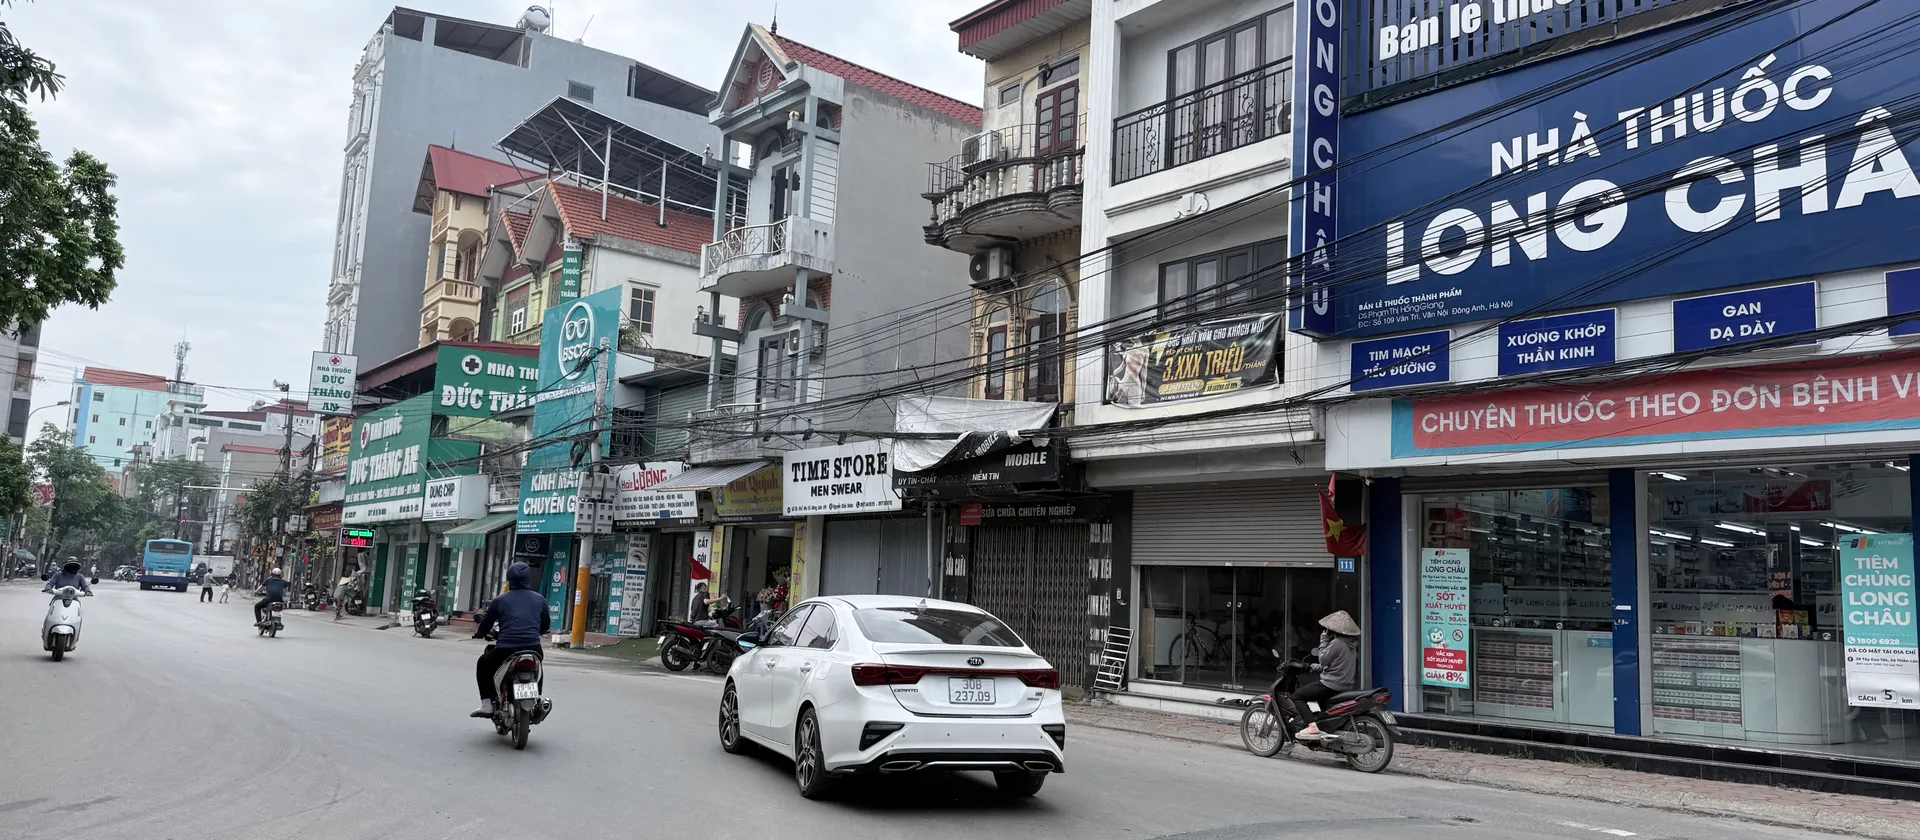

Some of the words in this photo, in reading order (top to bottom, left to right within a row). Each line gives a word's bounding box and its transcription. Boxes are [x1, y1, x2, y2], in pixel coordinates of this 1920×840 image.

[1380, 17, 1438, 60] Bán
[1491, 110, 1601, 177] NHÀ
[1618, 53, 1832, 151] THUỐC
[1311, 137, 1333, 316] CHÂU
[1386, 179, 1628, 286] LONG
[1358, 302, 1374, 311] BÁN
[1375, 300, 1383, 309] LẺ
[1384, 295, 1410, 308] THUỐC
[1411, 292, 1438, 303] THÀNH
[1439, 287, 1462, 300] PHẨM
[1373, 316, 1382, 326] Số
[1384, 316, 1395, 325] 109
[1437, 309, 1449, 318] Nội
[1452, 306, 1470, 316] Đông
[1471, 304, 1488, 313] Anh,
[1489, 302, 1500, 310] Hà
[1501, 300, 1514, 309] Nội
[1722, 301, 1761, 318] GAN
[1213, 328, 1226, 341] CHO
[1227, 323, 1250, 338] KHÁCH
[1507, 330, 1561, 348] XƯƠNG
[1564, 323, 1606, 341] KHỚP
[1710, 326, 1734, 342] DẠ
[1740, 320, 1776, 337] DÀY
[1369, 350, 1389, 362] TIM
[1392, 344, 1431, 361] MẠCH
[1517, 349, 1556, 365] THẦN
[1559, 345, 1595, 360] KINH
[487, 361, 515, 378] NHÀ
[1162, 353, 1203, 382] 3.XXX
[1389, 360, 1437, 376] ĐƯỜNG
[321, 374, 345, 385] ĐỨC
[312, 386, 351, 399] THẮNG
[441, 382, 484, 410] ĐỨC
[322, 402, 339, 413] AN
[1421, 404, 1516, 434] CHUYÊN
[1524, 391, 1615, 427] THUỐC
[1627, 387, 1702, 418] THEO
[1711, 384, 1781, 413] ĐƠN
[1793, 373, 1878, 413] BỆNH
[975, 430, 1000, 457] MOBILE
[791, 459, 830, 482] TIME
[833, 452, 888, 479] STORE
[1005, 451, 1048, 467] MOBILE
[531, 470, 557, 492] KÍNH
[621, 479, 633, 490] Hair
[898, 478, 907, 486] UY
[988, 472, 1000, 480] TIN
[810, 485, 829, 497] MEN
[831, 482, 863, 496] SWEAR
[523, 491, 565, 515] CHUYÊN
[981, 504, 995, 518] SỬA
[996, 504, 1016, 518] CHỮA
[1018, 505, 1046, 517] CHUYÊN
[1048, 503, 1077, 516] NGHIỆP
[1340, 560, 1353, 569] 111
[1446, 565, 1466, 573] CHÂU
[1854, 555, 1898, 570] TIÊM
[1845, 570, 1911, 587] CHỦNG
[1436, 590, 1456, 601] SỐT
[1849, 591, 1909, 606] LONG
[1424, 601, 1443, 609] XUẤT
[1444, 602, 1467, 611] HUYẾT
[1848, 608, 1911, 626] CHÂU
[969, 658, 983, 666] KIA
[962, 679, 983, 690] 30B
[1425, 671, 1445, 679] GIẢM
[1445, 671, 1464, 683] 8%
[955, 690, 991, 703] 237.09
[1884, 689, 1893, 701] 5
